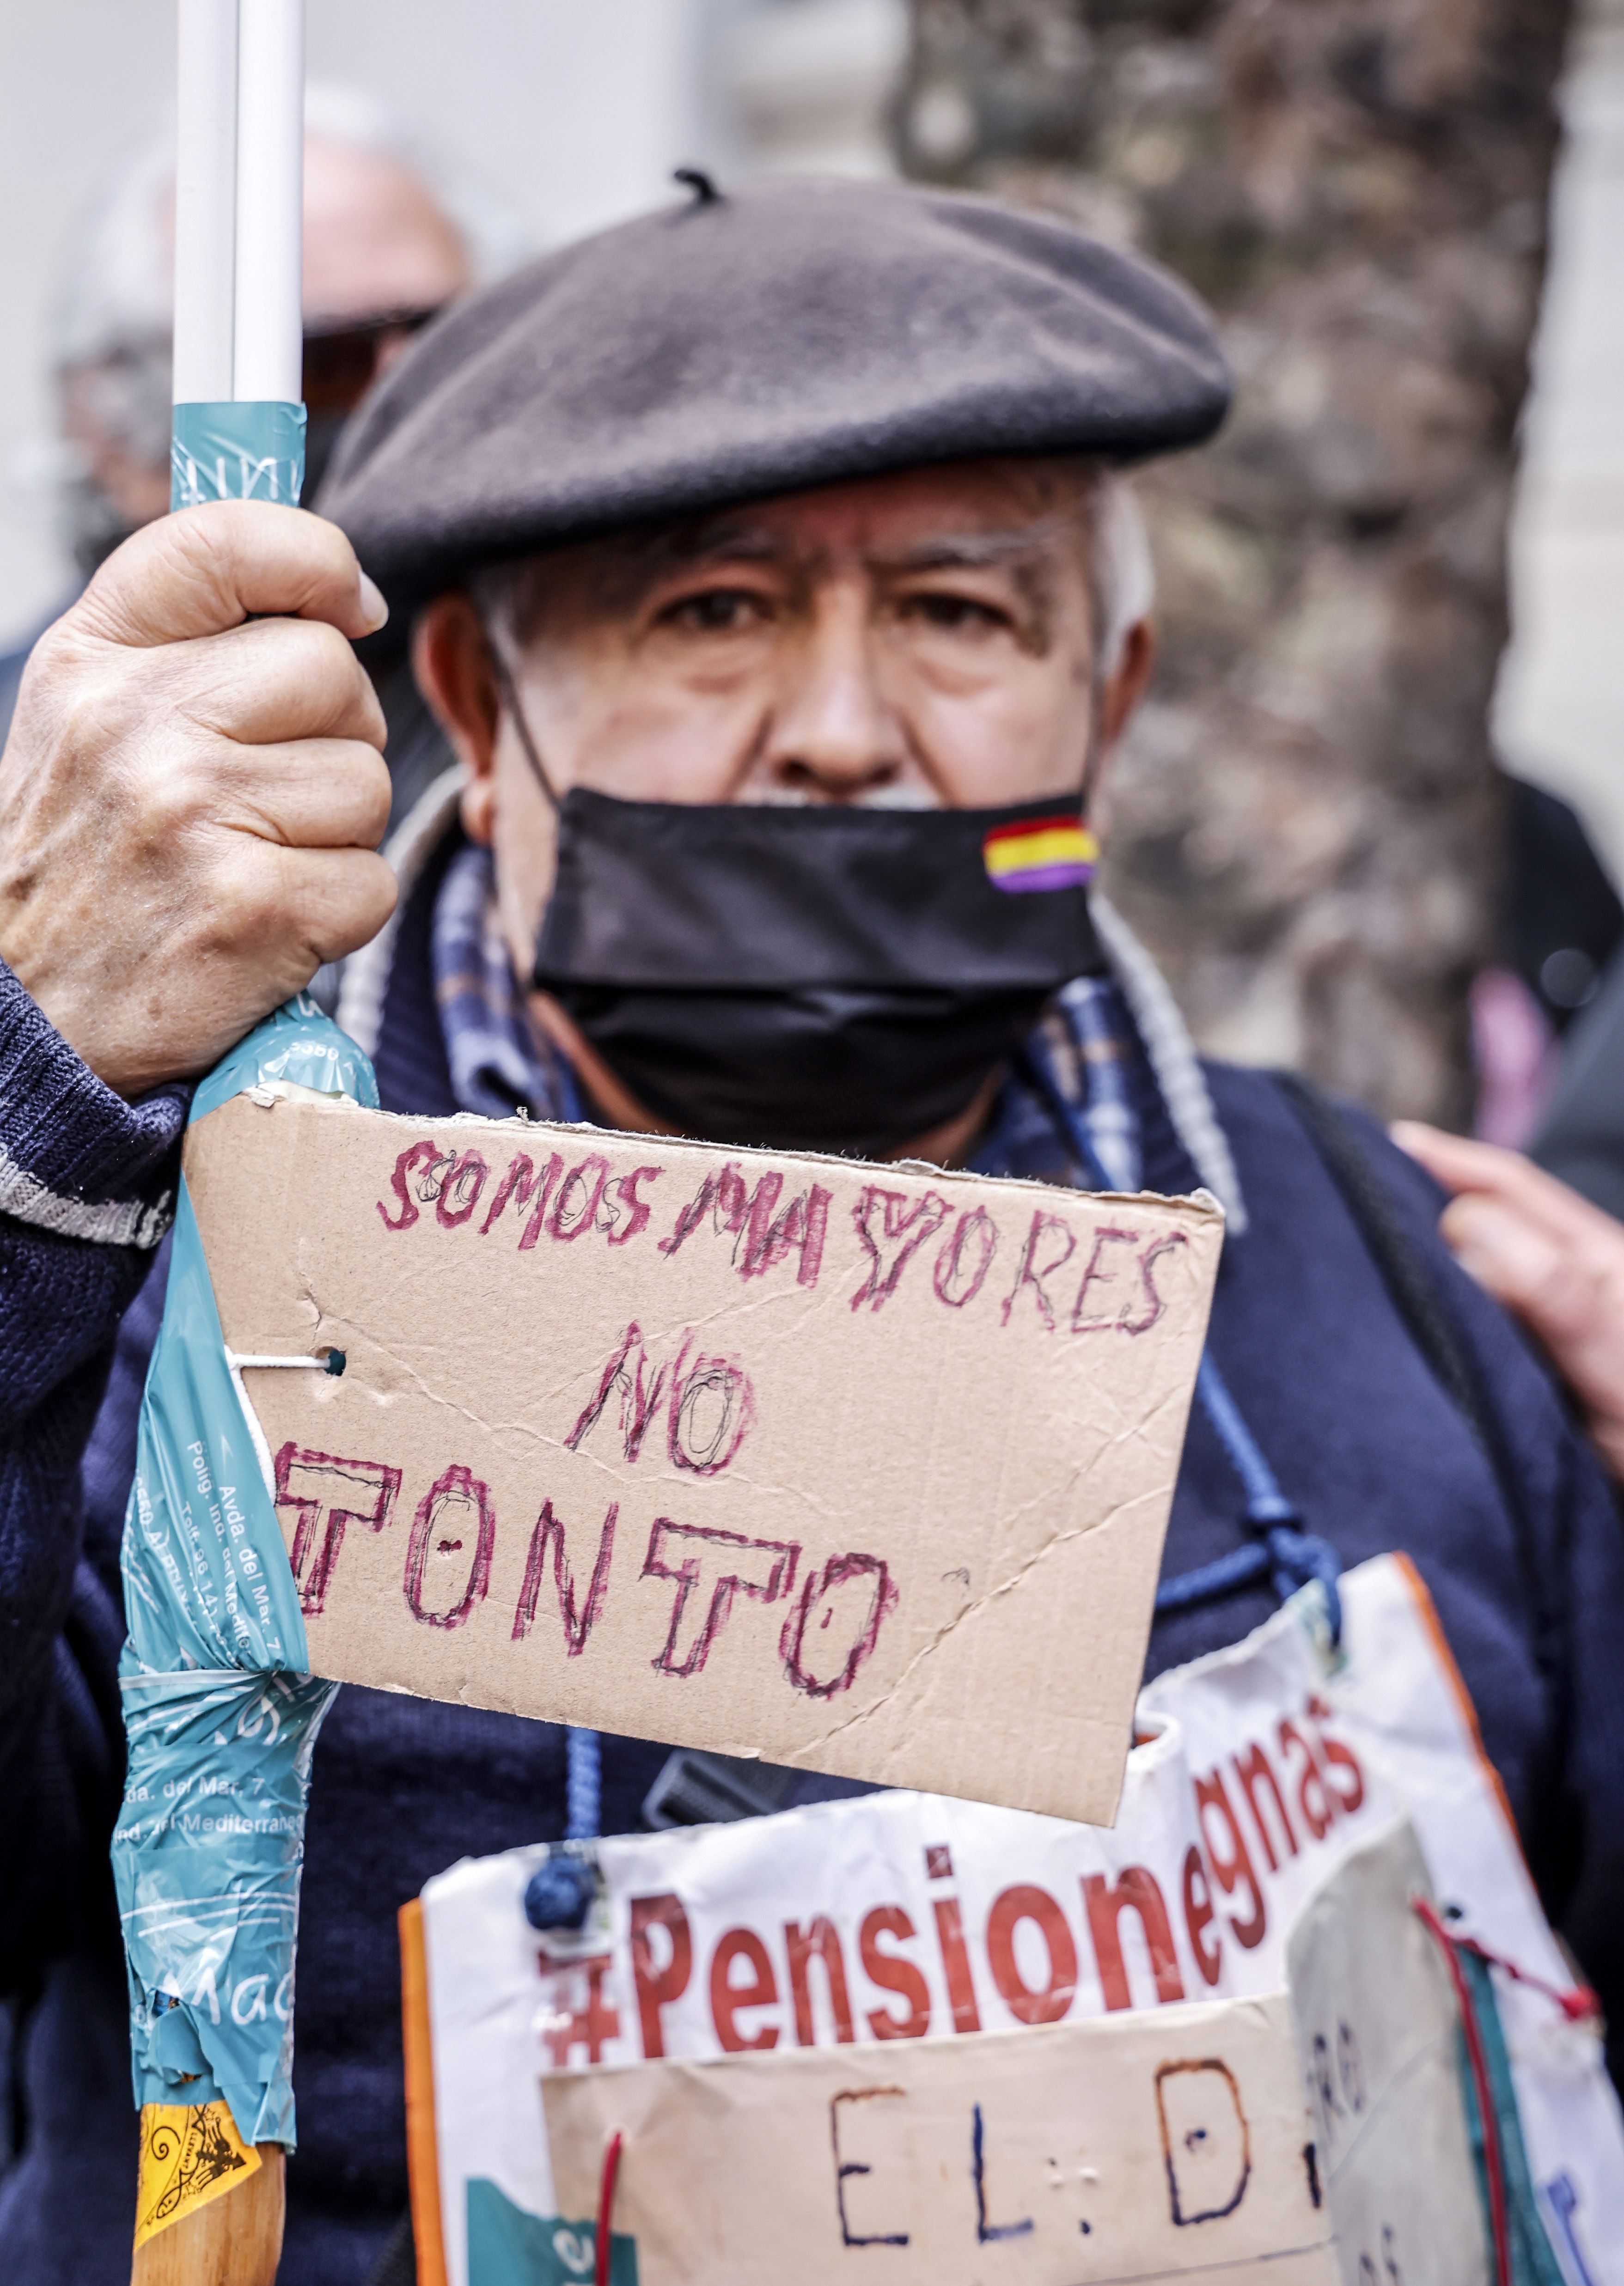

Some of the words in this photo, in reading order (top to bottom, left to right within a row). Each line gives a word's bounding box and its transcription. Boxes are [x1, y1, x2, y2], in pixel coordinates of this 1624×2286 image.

[376, 1140, 666, 1250] SOMOS
[562, 1319, 758, 1477] NO
[219, 1486, 245, 1542] Avda.
[238, 1548, 263, 1581] del
[266, 1636, 281, 1649] 7
[274, 1440, 899, 1701] TONTO
[251, 1778, 265, 1795] 7
